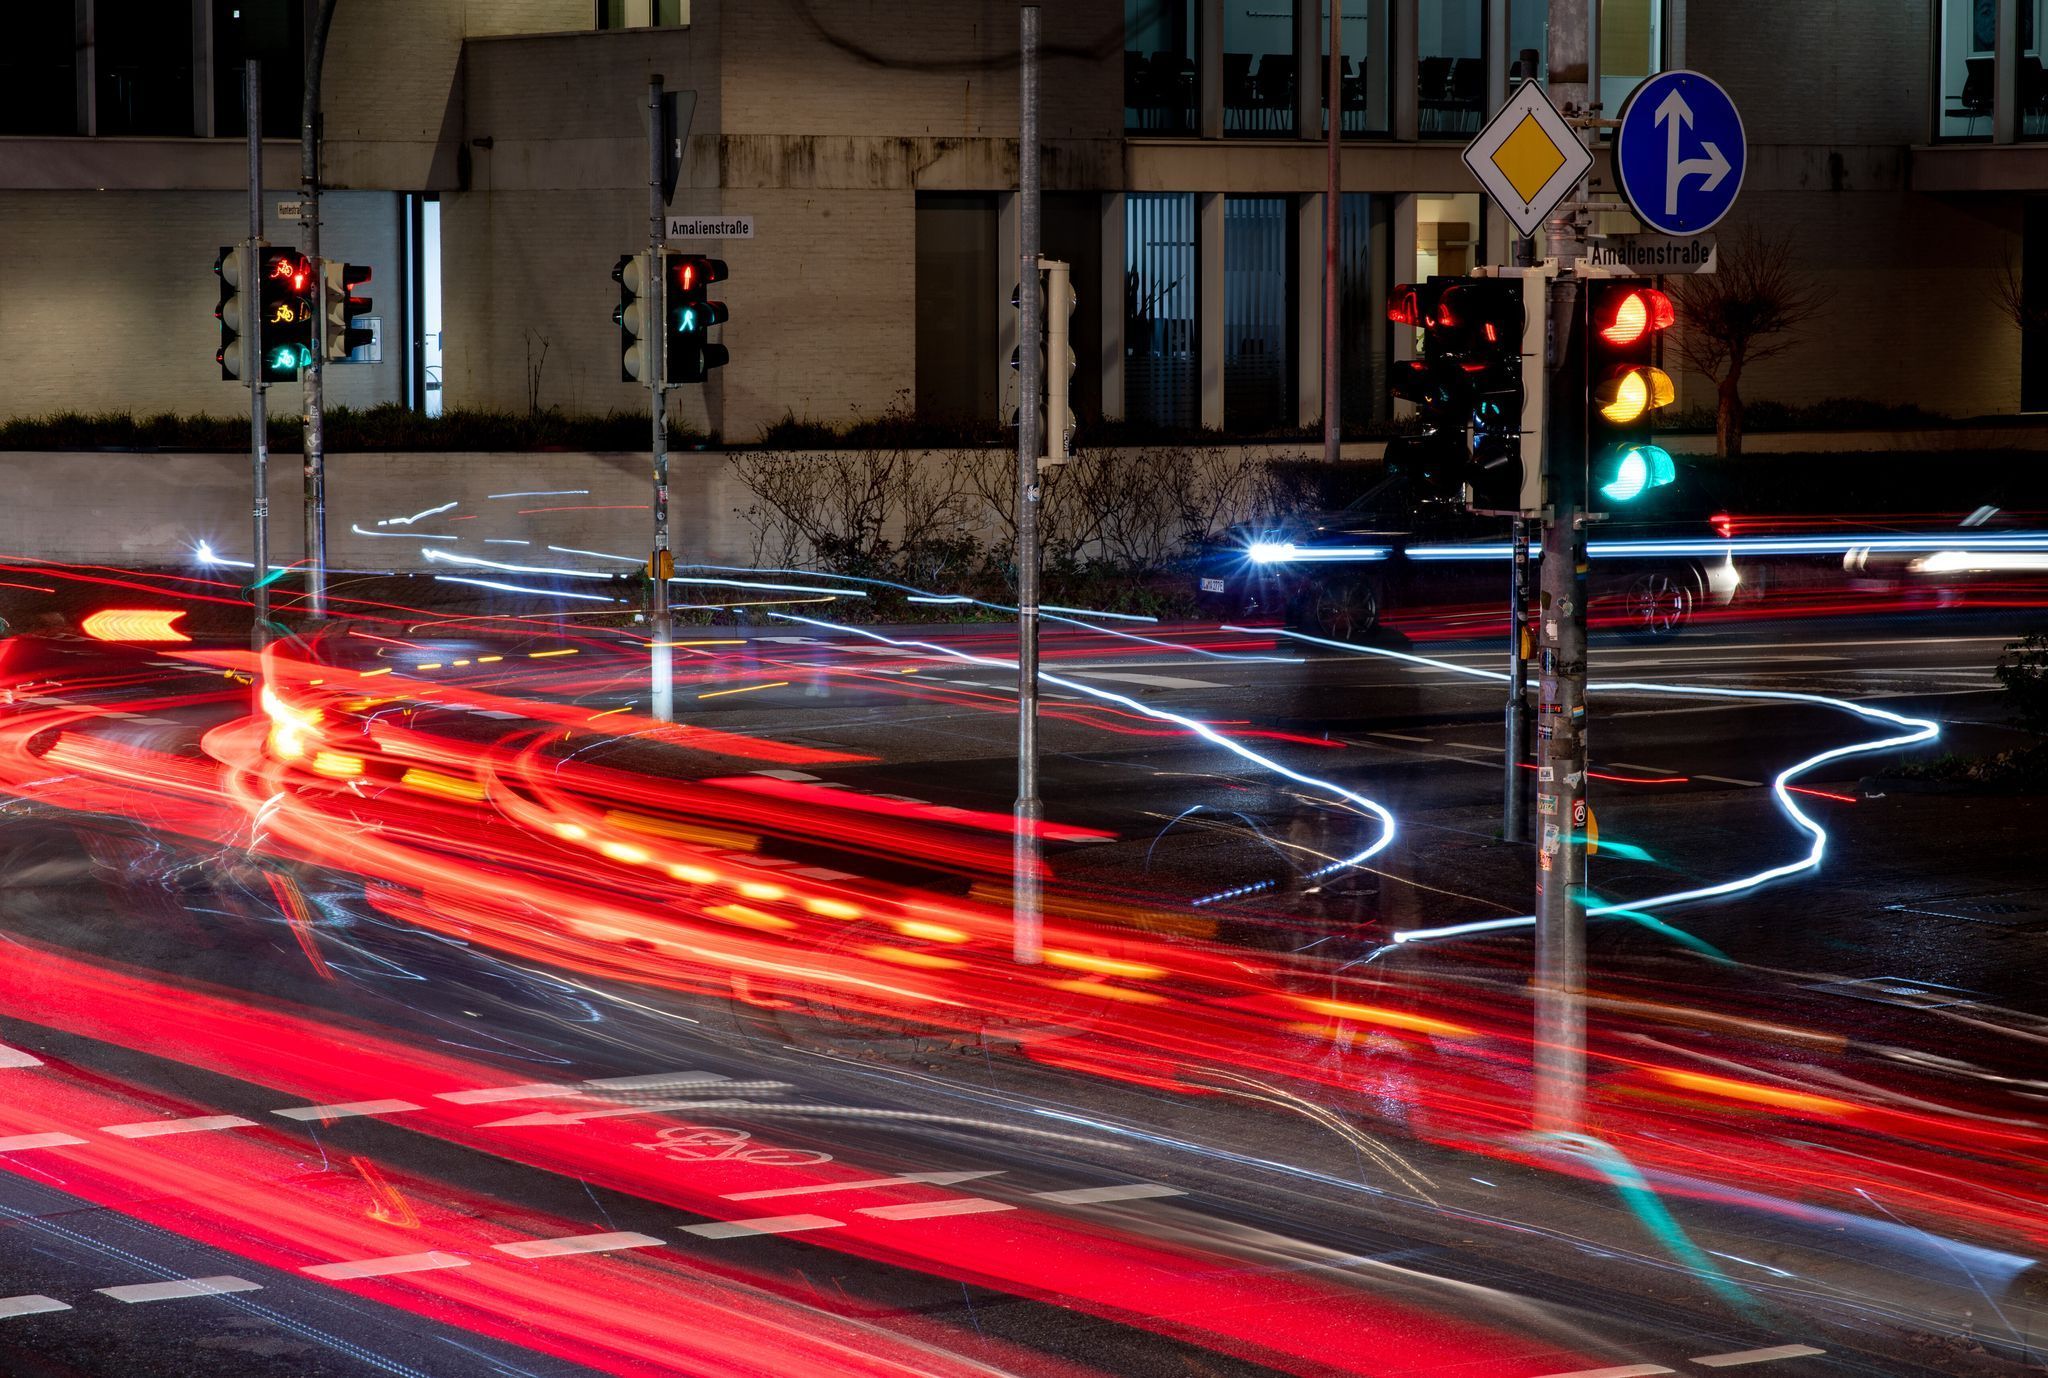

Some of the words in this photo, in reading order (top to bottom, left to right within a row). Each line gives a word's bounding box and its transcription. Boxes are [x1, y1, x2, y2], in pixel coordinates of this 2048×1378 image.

[279, 204, 301, 215] Huntestra
[671, 220, 749, 235] Amalienstraße
[1591, 240, 1709, 266] Amalienstraße
